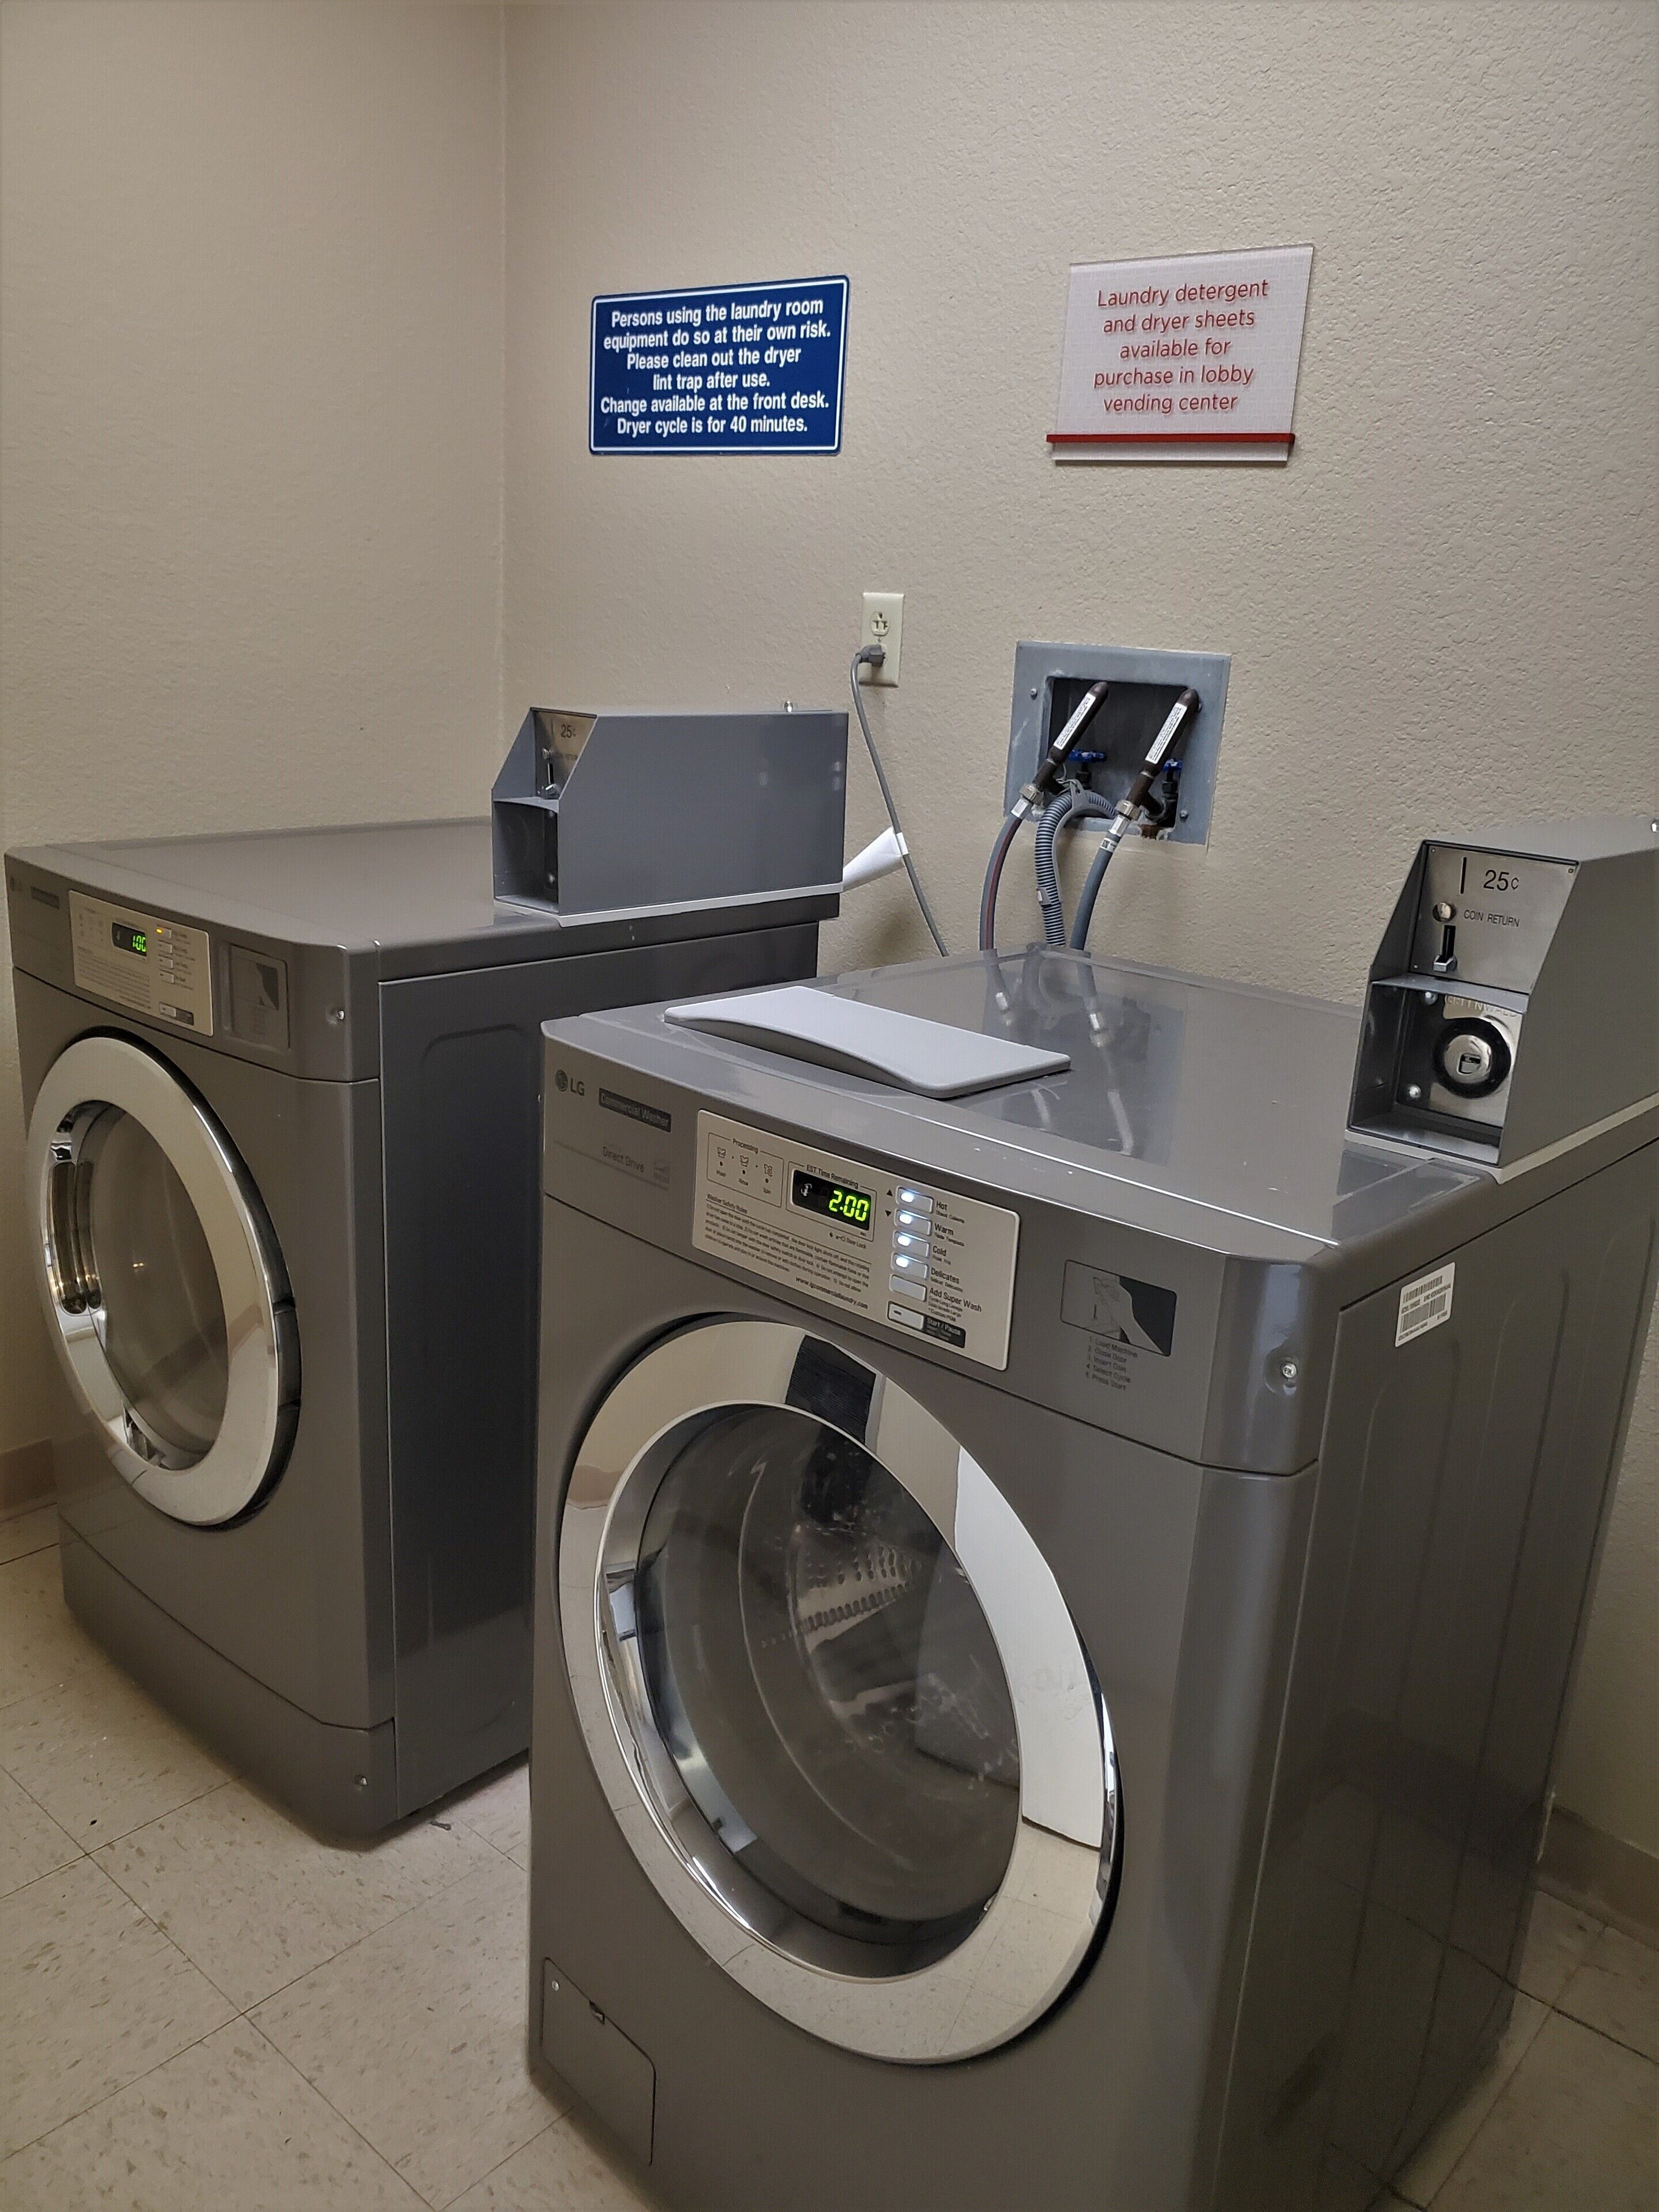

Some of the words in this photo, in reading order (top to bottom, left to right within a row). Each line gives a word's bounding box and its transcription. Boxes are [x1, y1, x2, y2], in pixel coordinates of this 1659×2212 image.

[1098, 287, 1169, 306] Laundry
[1175, 279, 1268, 302] detergent
[612, 310, 662, 328] Persons
[666, 306, 702, 326] using
[706, 304, 726, 321] the
[731, 300, 781, 321] laundry
[786, 299, 823, 315] room
[1104, 315, 1135, 333] and
[1142, 314, 1189, 334] dryer
[1195, 309, 1255, 328] sheets
[604, 332, 668, 353] equipment
[672, 329, 689, 345] do
[694, 332, 710, 344] so
[714, 329, 727, 342] at
[732, 325, 763, 342] their
[767, 325, 796, 340] own
[800, 320, 831, 338] risk.
[627, 353, 669, 370] Please
[673, 350, 707, 368] clean
[711, 350, 733, 366] out
[738, 349, 760, 365] the
[764, 347, 801, 368] dryer
[1120, 339, 1198, 359] available
[1205, 338, 1231, 355] for
[653, 374, 672, 391] lint
[677, 375, 702, 392] trap
[707, 372, 738, 388] after
[742, 373, 770, 387] use.
[1094, 368, 1173, 388] purchase
[1179, 366, 1194, 384] in
[1200, 365, 1254, 385] lobby
[601, 397, 647, 416] Change
[651, 395, 705, 412] available
[709, 396, 722, 410] at
[727, 394, 748, 410] the
[753, 393, 786, 409] front
[790, 391, 829, 408] desk.
[1104, 394, 1172, 414] vending
[1179, 394, 1237, 410] center
[618, 418, 650, 438] Dryer
[655, 418, 688, 437] cycle
[692, 418, 702, 433] is
[707, 416, 726, 433] for
[730, 416, 747, 432] 40
[751, 415, 808, 432] minutes.
[1464, 910, 1483, 921] COIN
[1487, 914, 1520, 927] RETURN
[570, 1078, 585, 1096] LG
[642, 1109, 669, 1126] Washer
[603, 1146, 623, 1164] Direct
[626, 1156, 645, 1172] Drive
[806, 1165, 817, 1173] EST
[818, 1168, 830, 1179] Time
[831, 1173, 858, 1189] Remaining
[936, 1200, 947, 1210] Hot
[935, 1223, 953, 1236] Warm
[933, 1245, 946, 1256] Cold
[931, 1267, 959, 1283] Delicates
[930, 1287, 942, 1297] Add
[944, 1292, 961, 1304] Super
[963, 1299, 982, 1312] Wash
